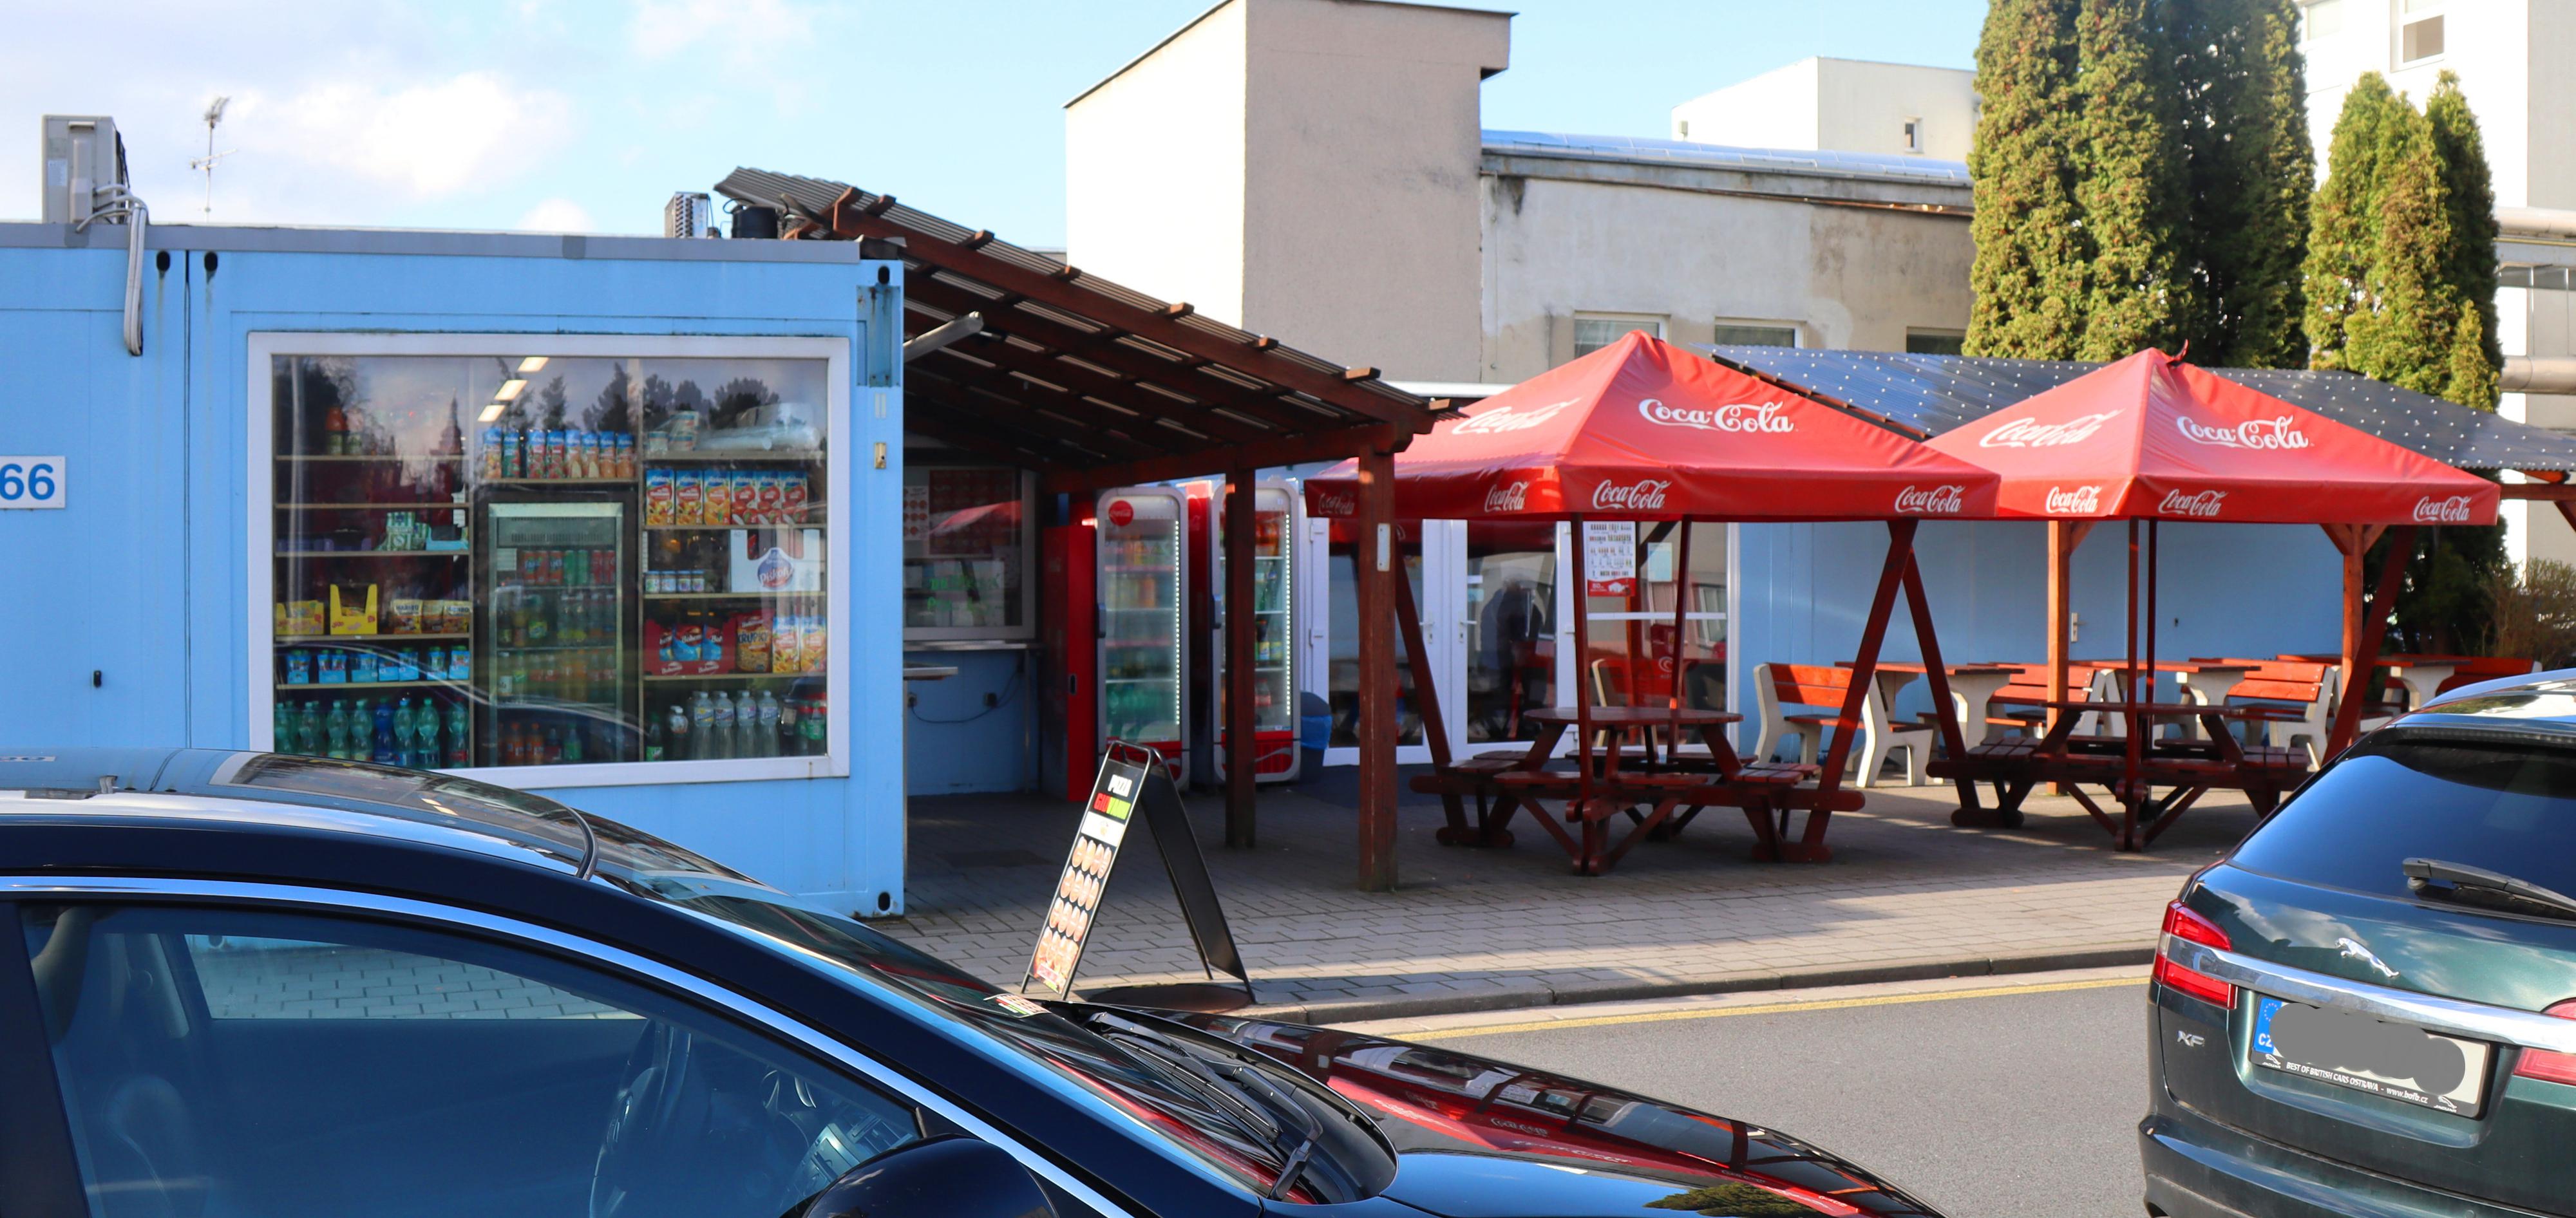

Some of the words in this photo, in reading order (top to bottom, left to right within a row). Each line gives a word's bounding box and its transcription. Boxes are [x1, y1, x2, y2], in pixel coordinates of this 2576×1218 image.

[1452, 397, 1582, 435] Coca-Cola
[1639, 398, 1794, 433] Coca-Cola
[1980, 409, 2125, 448] Coca-Cola
[2177, 415, 2309, 449] Coca-Cola
[0, 464, 55, 500] 66
[1484, 482, 1530, 512] Coca-Cola
[1593, 479, 1672, 510] Coca-Cola
[1895, 485, 1965, 513] Coca-Cola
[2045, 485, 2102, 514] Coca-Cola
[2158, 489, 2229, 517] Coca-Cola
[2413, 495, 2471, 522] Coca-Cola
[2177, 1030, 2205, 1047] XF
[2258, 1033, 2273, 1047] CZ
[2286, 1062, 2301, 1071] BEST
[2309, 1068, 2333, 1080] BRITISH
[2333, 1074, 2349, 1084] CARS
[2349, 1078, 2379, 1092] OSTRAVA
